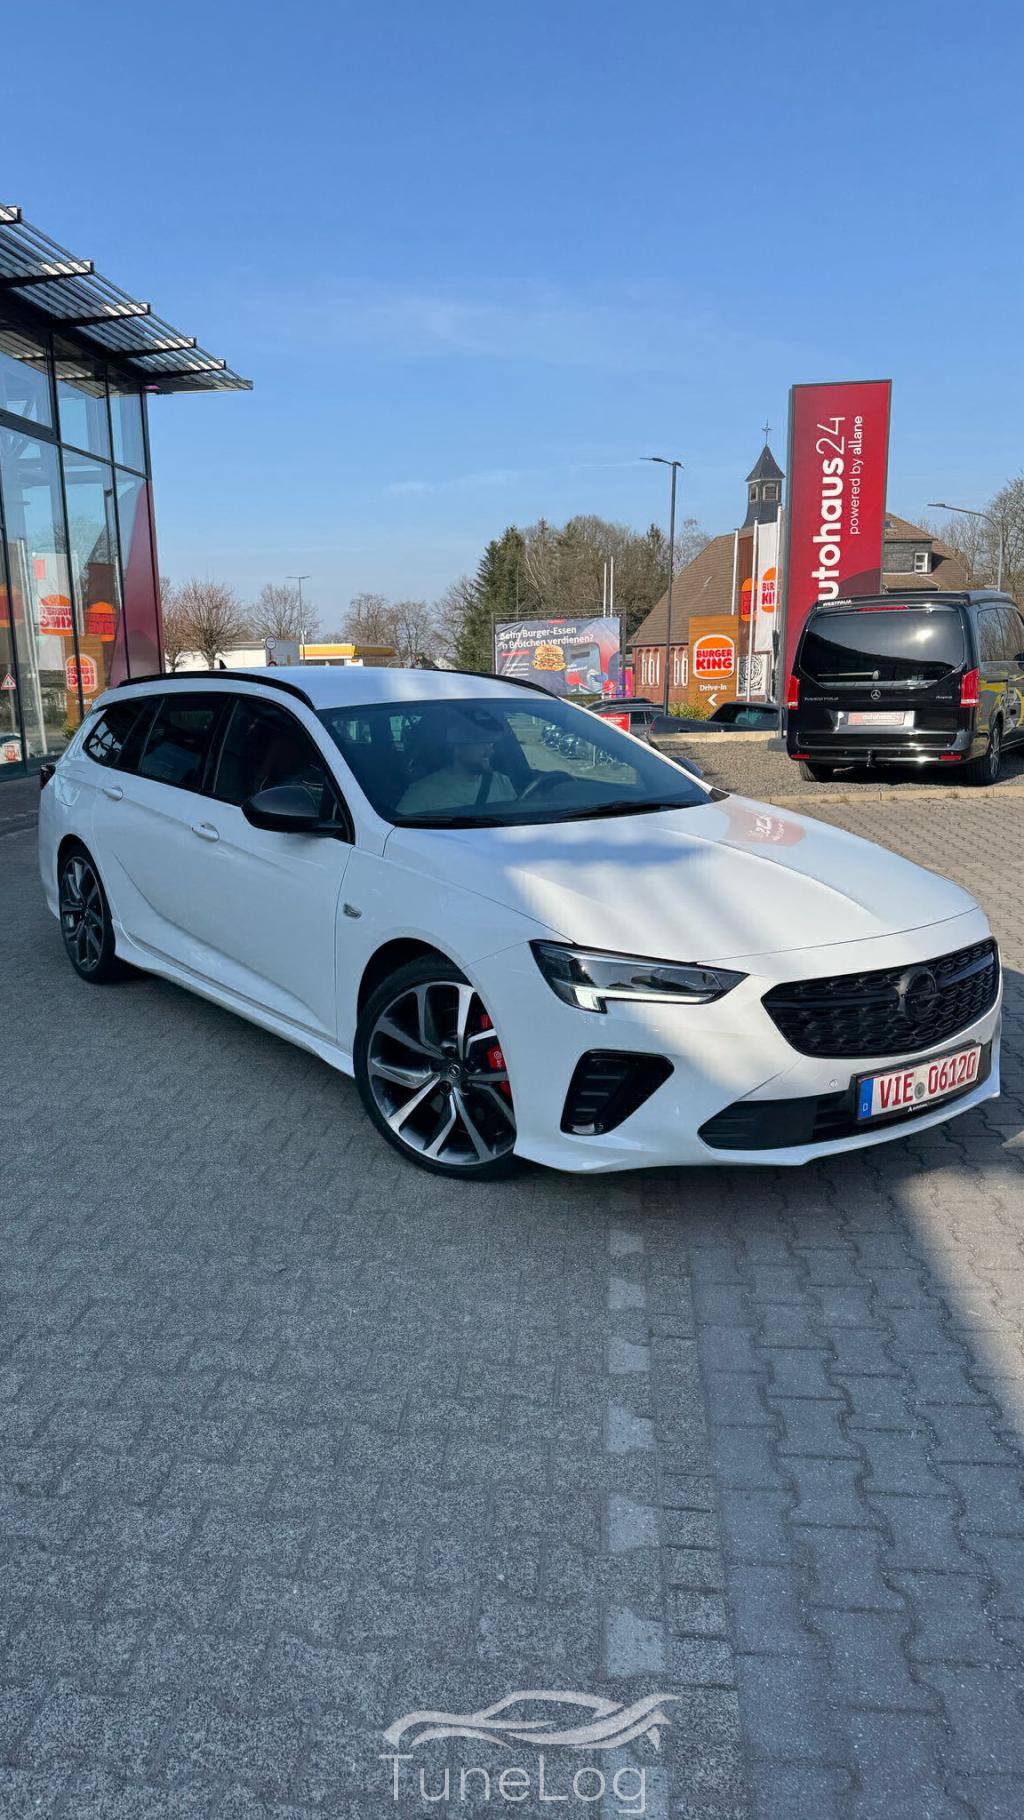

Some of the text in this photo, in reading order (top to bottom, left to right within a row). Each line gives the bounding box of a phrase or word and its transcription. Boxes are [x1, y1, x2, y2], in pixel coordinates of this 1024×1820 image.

[848, 416, 864, 535] powered by allane
[811, 417, 845, 600] utohaus24
[523, 626, 577, 639] Burger-Essen
[509, 639, 546, 649] Brötchen
[548, 635, 594, 646] verdienen?
[696, 649, 733, 658] BURGER
[696, 658, 733, 670] KING
[880, 1051, 976, 1109] VIE 06120
[863, 1104, 869, 1112] D
